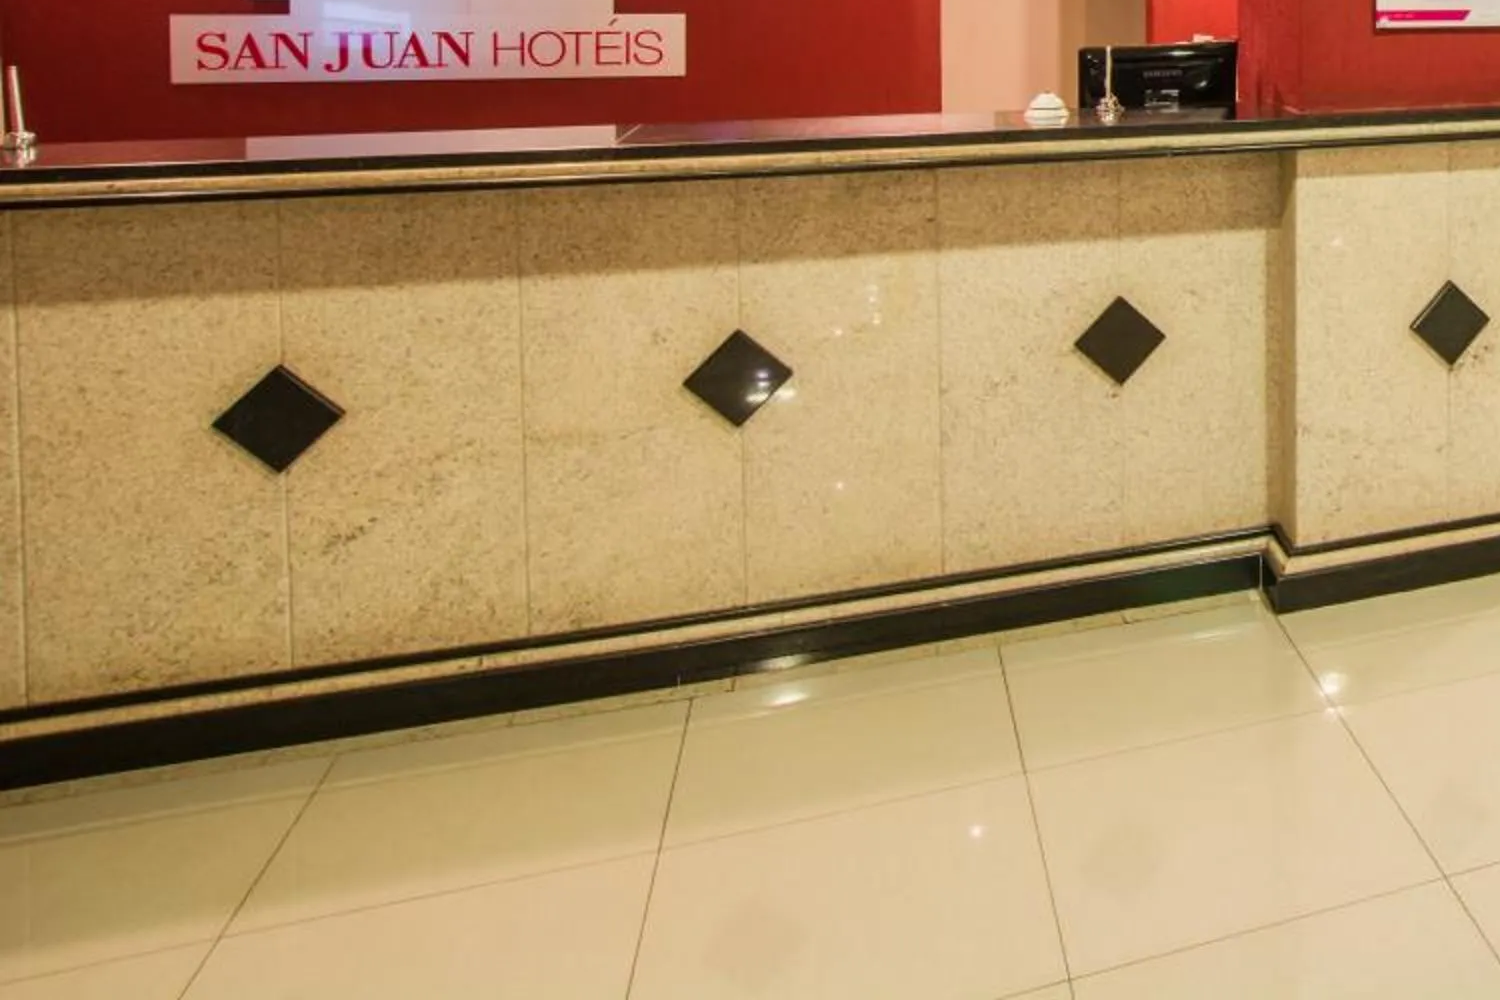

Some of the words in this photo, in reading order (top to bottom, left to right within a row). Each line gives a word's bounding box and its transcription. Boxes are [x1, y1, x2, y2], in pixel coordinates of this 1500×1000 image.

[196, 31, 309, 71] SAN
[323, 31, 473, 74] JUAN
[493, 18, 664, 67] HOTÉIS
